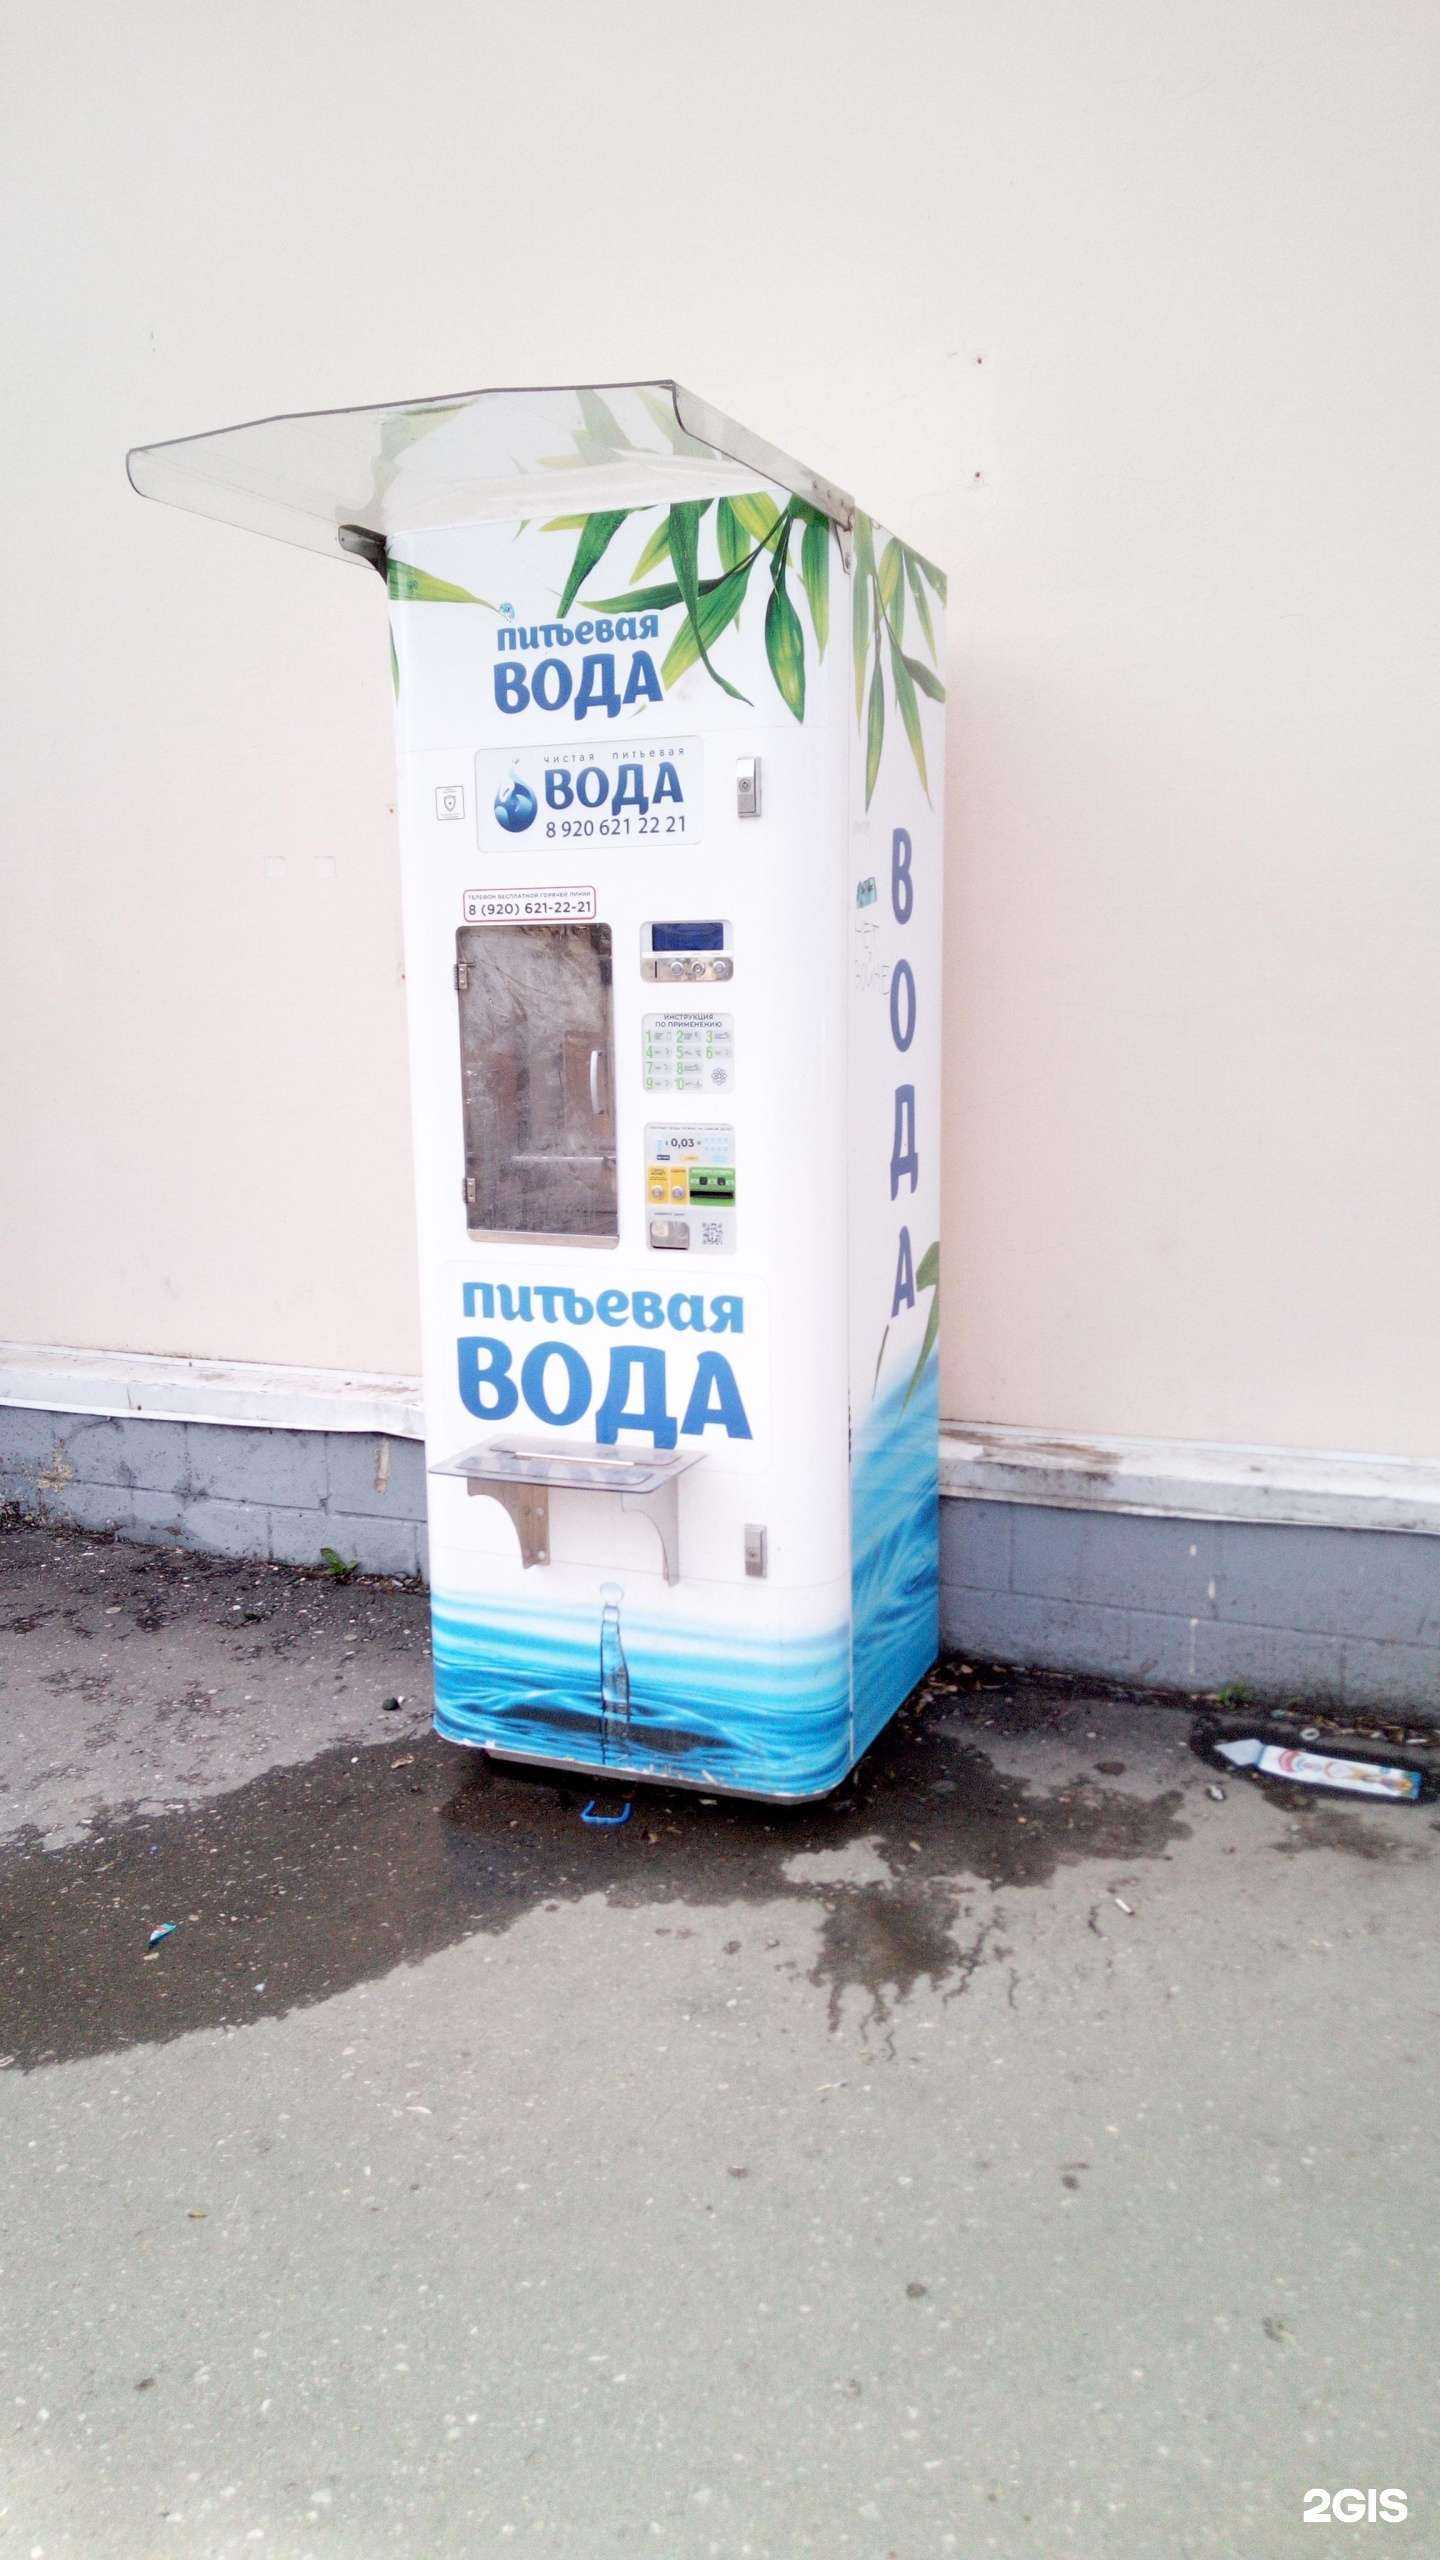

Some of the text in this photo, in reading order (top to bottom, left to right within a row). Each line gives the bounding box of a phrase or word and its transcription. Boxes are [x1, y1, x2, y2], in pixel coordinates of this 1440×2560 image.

[497, 614, 659, 651] питьевая
[493, 650, 664, 721] ВОДА
[543, 748, 685, 763] чистая питьевая
[544, 761, 684, 816] ВОДА
[545, 816, 686, 838] 8 920 621 22 21
[468, 901, 591, 916] 8 (920) 621-22-21
[664, 1013, 714, 1021] ИНСТРУКЦИЯ
[676, 1030, 684, 1043] 2
[706, 1030, 713, 1043] 3
[646, 1045, 653, 1058] 4
[677, 1045, 684, 1059] 5
[706, 1046, 713, 1059] 6
[889, 826, 919, 1318] ВОДА
[671, 1138, 695, 1149] 0,03
[462, 1281, 744, 1334] питьевая
[456, 1335, 754, 1450] ВОДА
